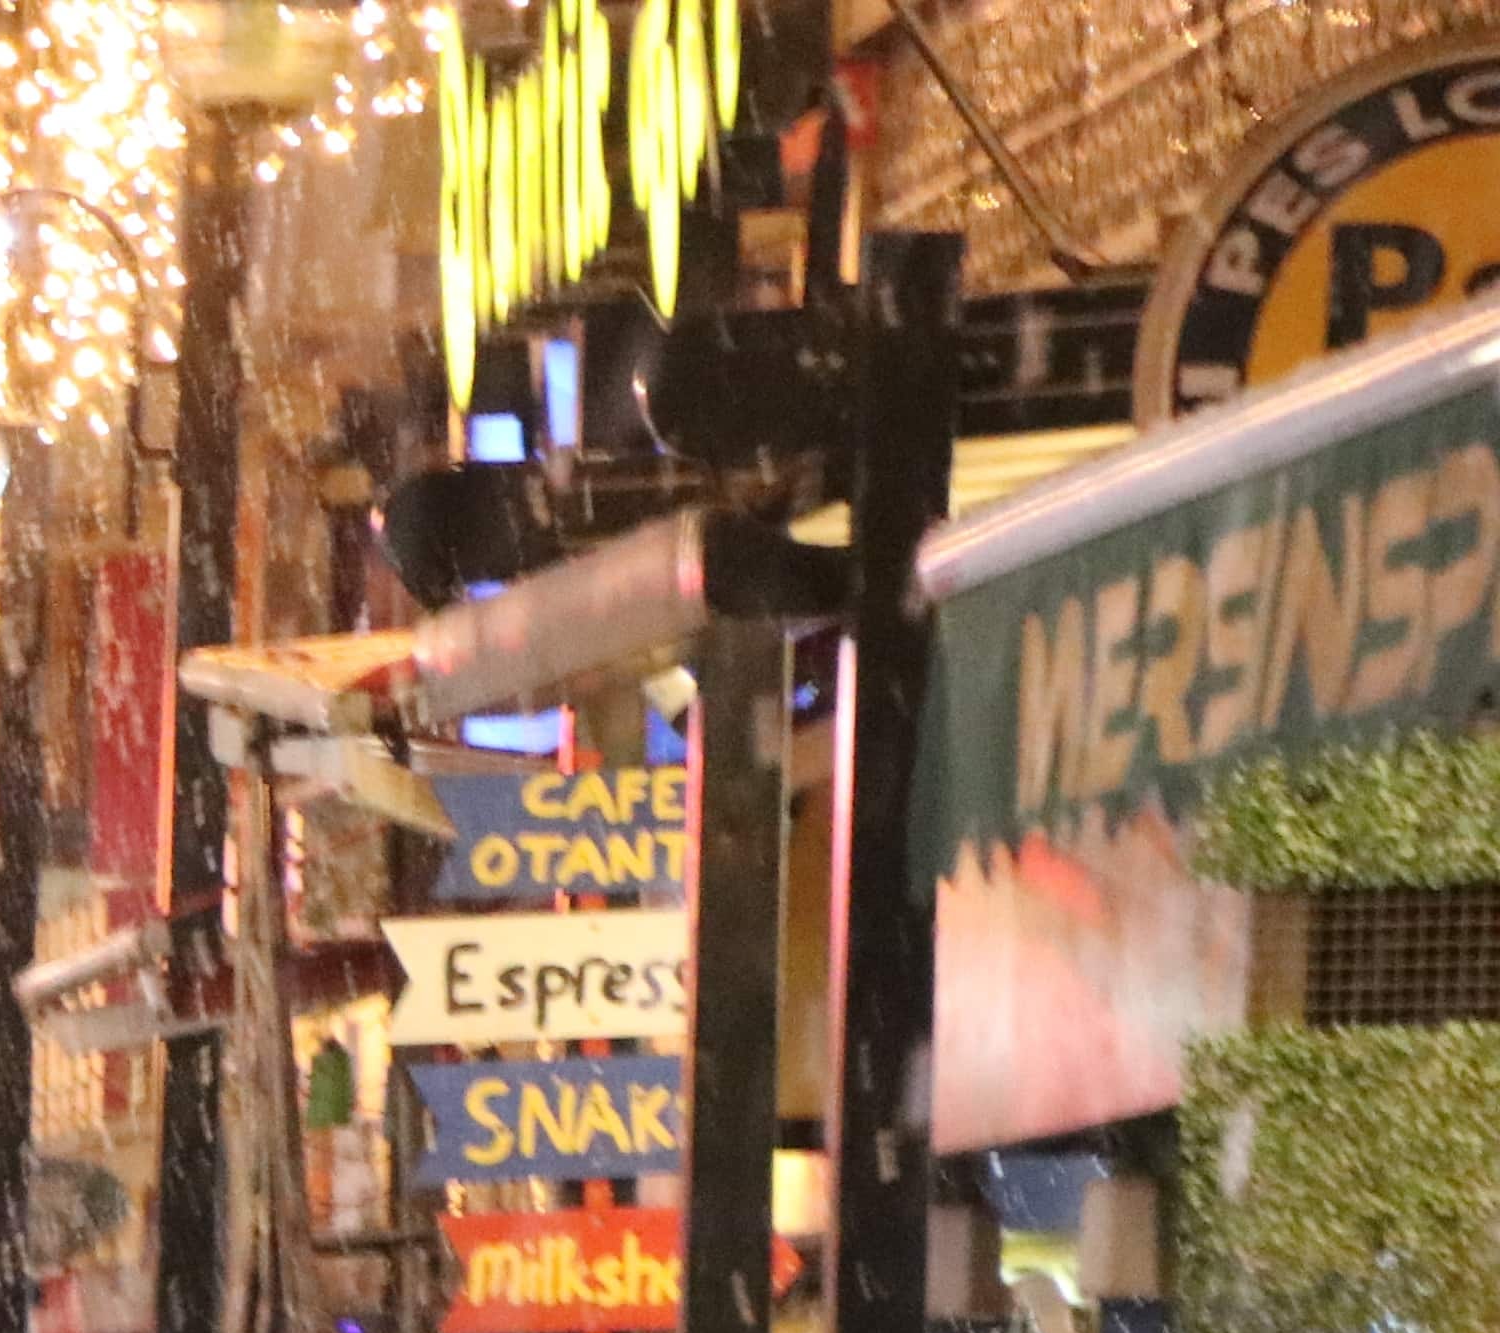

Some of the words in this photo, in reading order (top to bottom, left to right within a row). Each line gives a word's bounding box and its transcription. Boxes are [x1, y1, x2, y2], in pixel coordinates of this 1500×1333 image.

[1206, 122, 1371, 297] PES
[1326, 223, 1500, 350] P
[521, 765, 687, 824] CAFE
[470, 829, 690, 887] OTANT
[463, 1078, 692, 1166] SNAK
